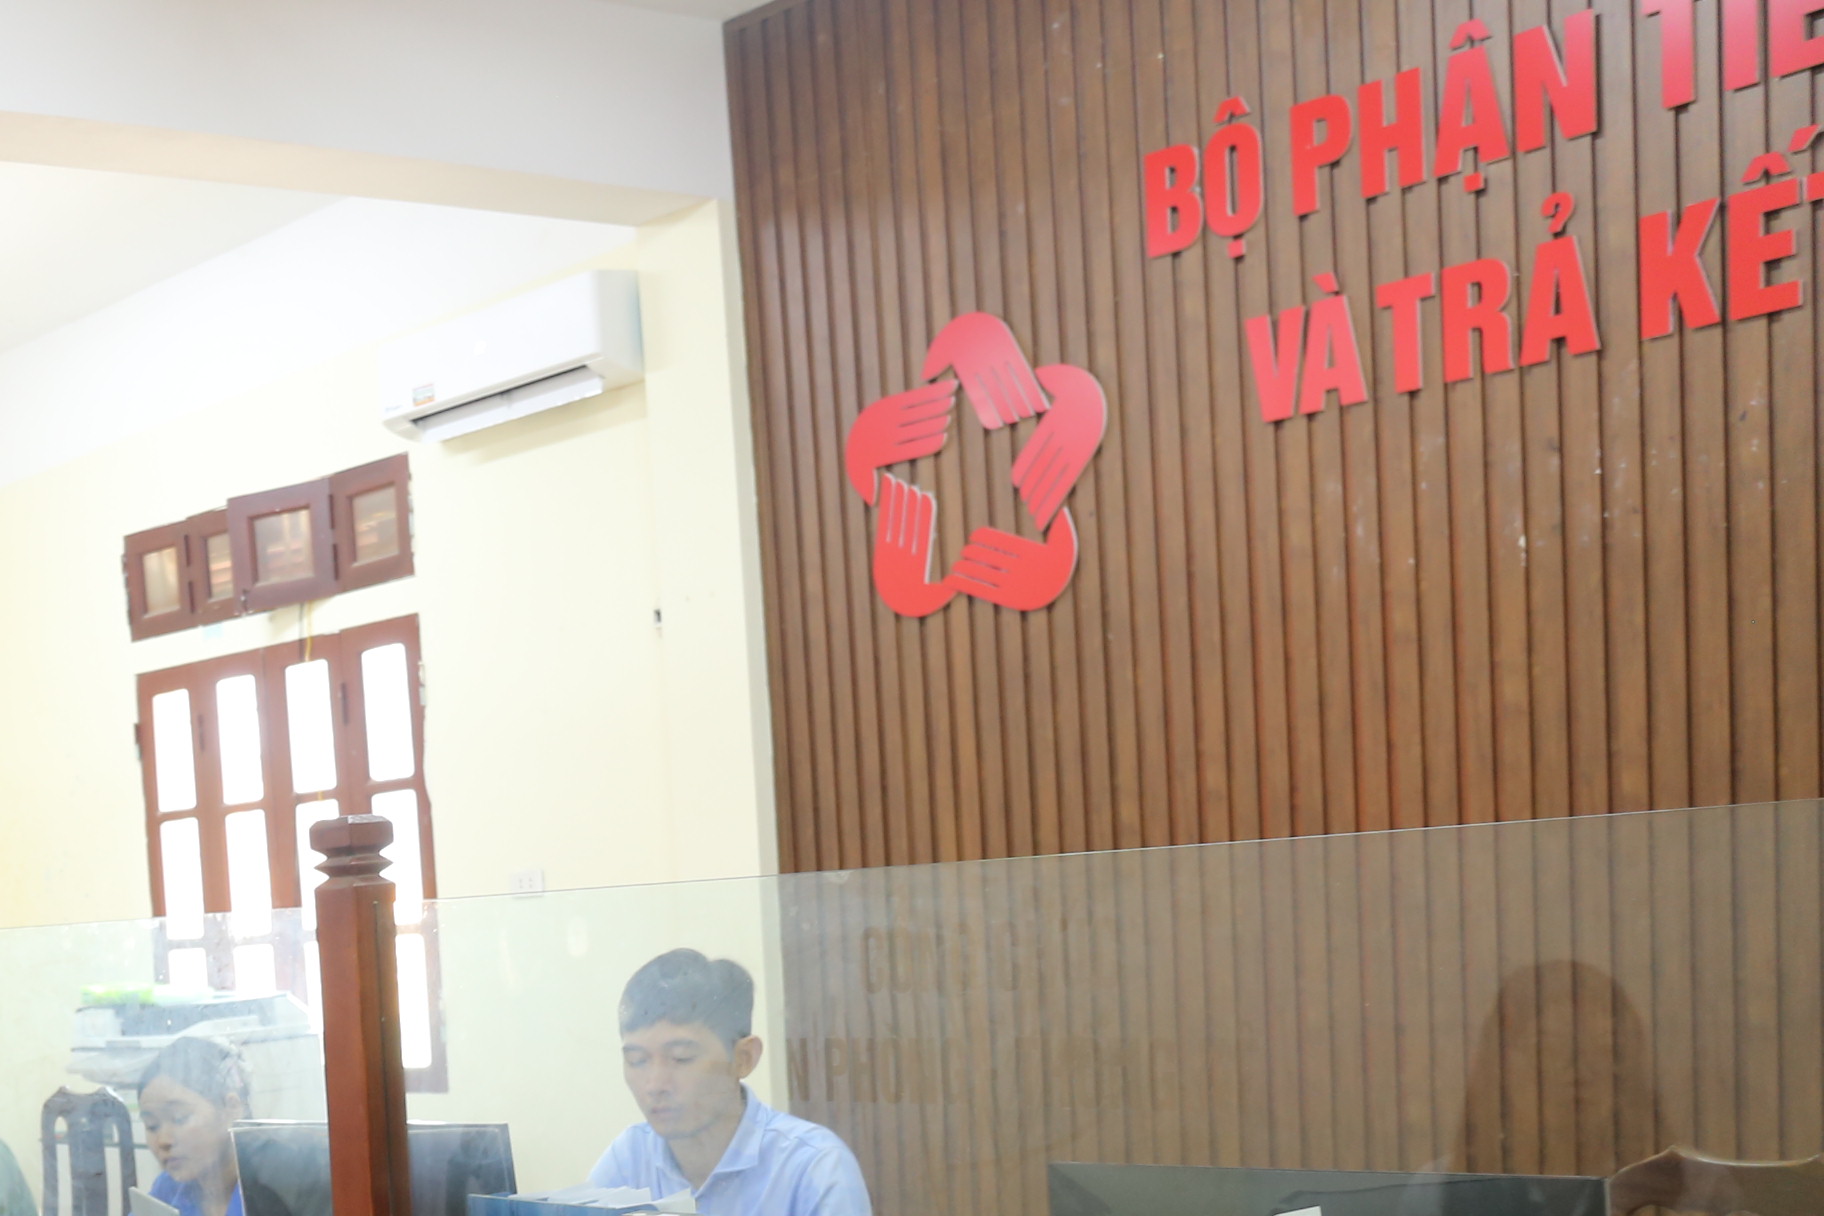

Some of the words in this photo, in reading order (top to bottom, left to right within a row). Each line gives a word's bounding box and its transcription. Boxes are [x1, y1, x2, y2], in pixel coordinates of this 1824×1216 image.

[1144, 97, 1264, 258] BỘ
[1290, 8, 1597, 217] PHẬN
[1245, 272, 1367, 424] VÀ
[1377, 193, 1601, 395] TRẢ
[1640, 125, 1824, 340] KẾ
